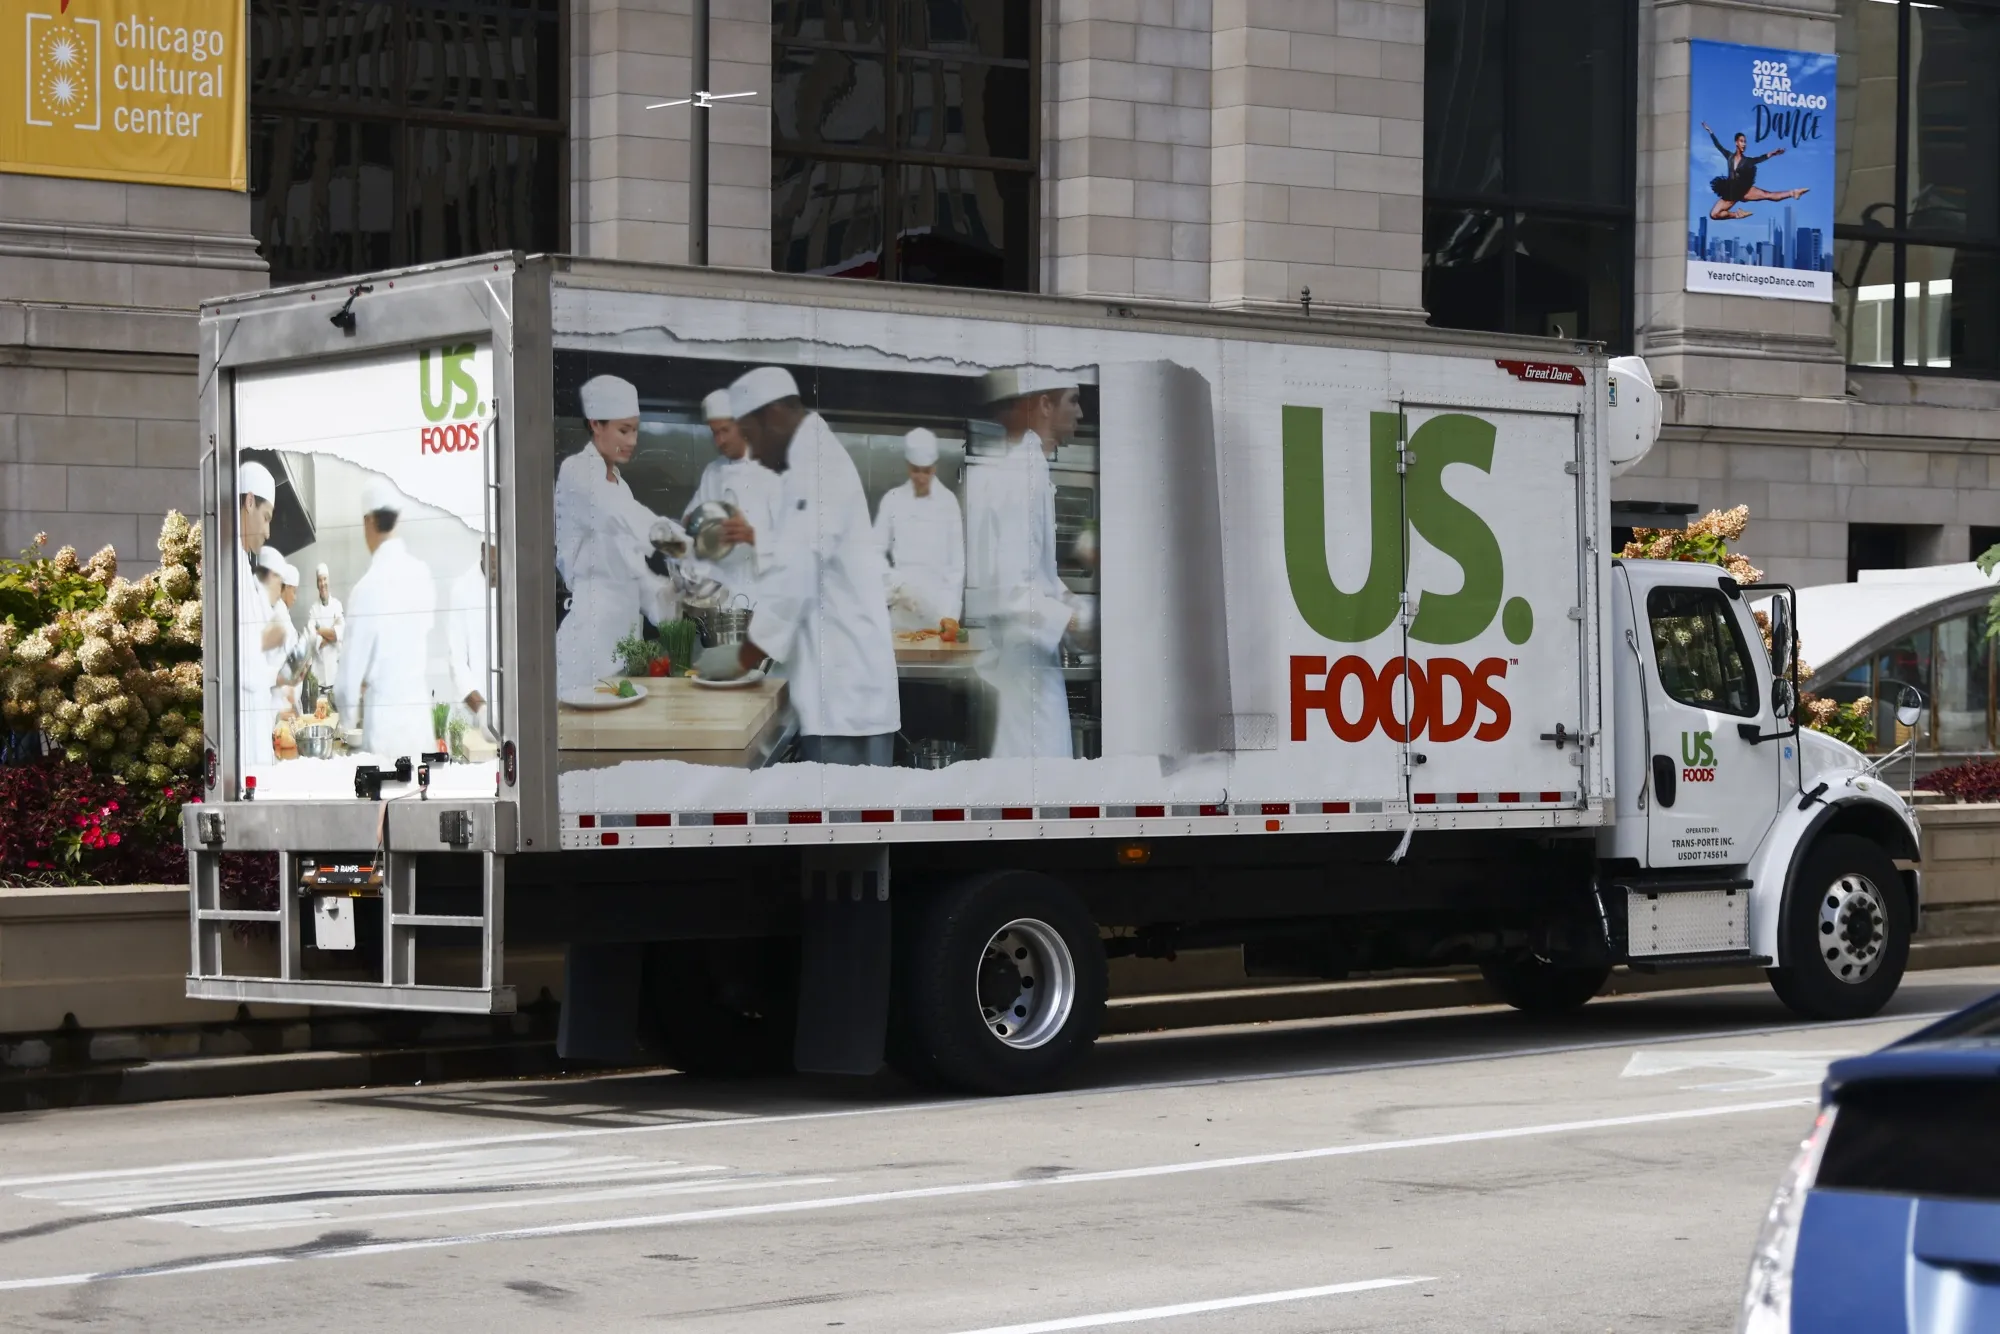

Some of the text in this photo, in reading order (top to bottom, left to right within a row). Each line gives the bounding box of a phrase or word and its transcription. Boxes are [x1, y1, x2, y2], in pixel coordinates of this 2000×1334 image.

[114, 14, 224, 62] chicago
[114, 58, 223, 98] cultural
[1752, 59, 1788, 77] 2022
[1752, 74, 1792, 92] YEAR
[1752, 88, 1828, 110] OF CHICAGO
[114, 103, 203, 137] center
[1707, 270, 1815, 289] YearofChicagoDance.com
[418, 342, 486, 423] US.
[1525, 364, 1573, 382] Great Dane
[421, 422, 480, 456] FOODS
[1281, 404, 1534, 646] US.
[1289, 654, 1512, 743] FOODS
[1681, 730, 1718, 767] US.
[1682, 767, 1715, 782] FOODS
[1671, 836, 1735, 848] TRANS-PORTE INC.
[1678, 850, 1728, 861] USDOT 745614
